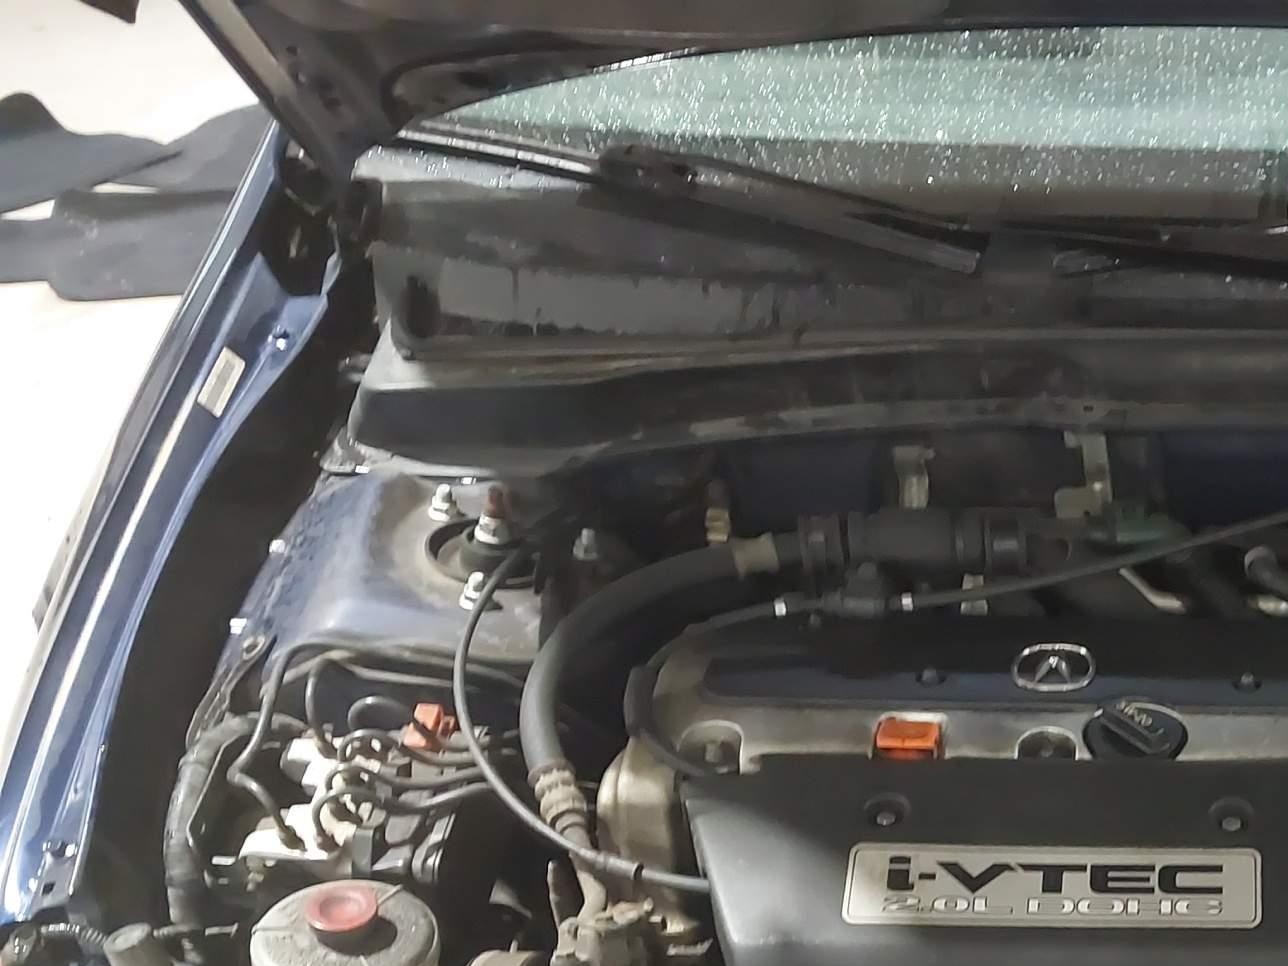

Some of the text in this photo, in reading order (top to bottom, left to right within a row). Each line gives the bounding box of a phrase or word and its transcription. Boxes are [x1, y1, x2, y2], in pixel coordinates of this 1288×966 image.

[886, 855, 1224, 894] i-VTEC
[880, 896, 1223, 915] 2.0L DOHC
